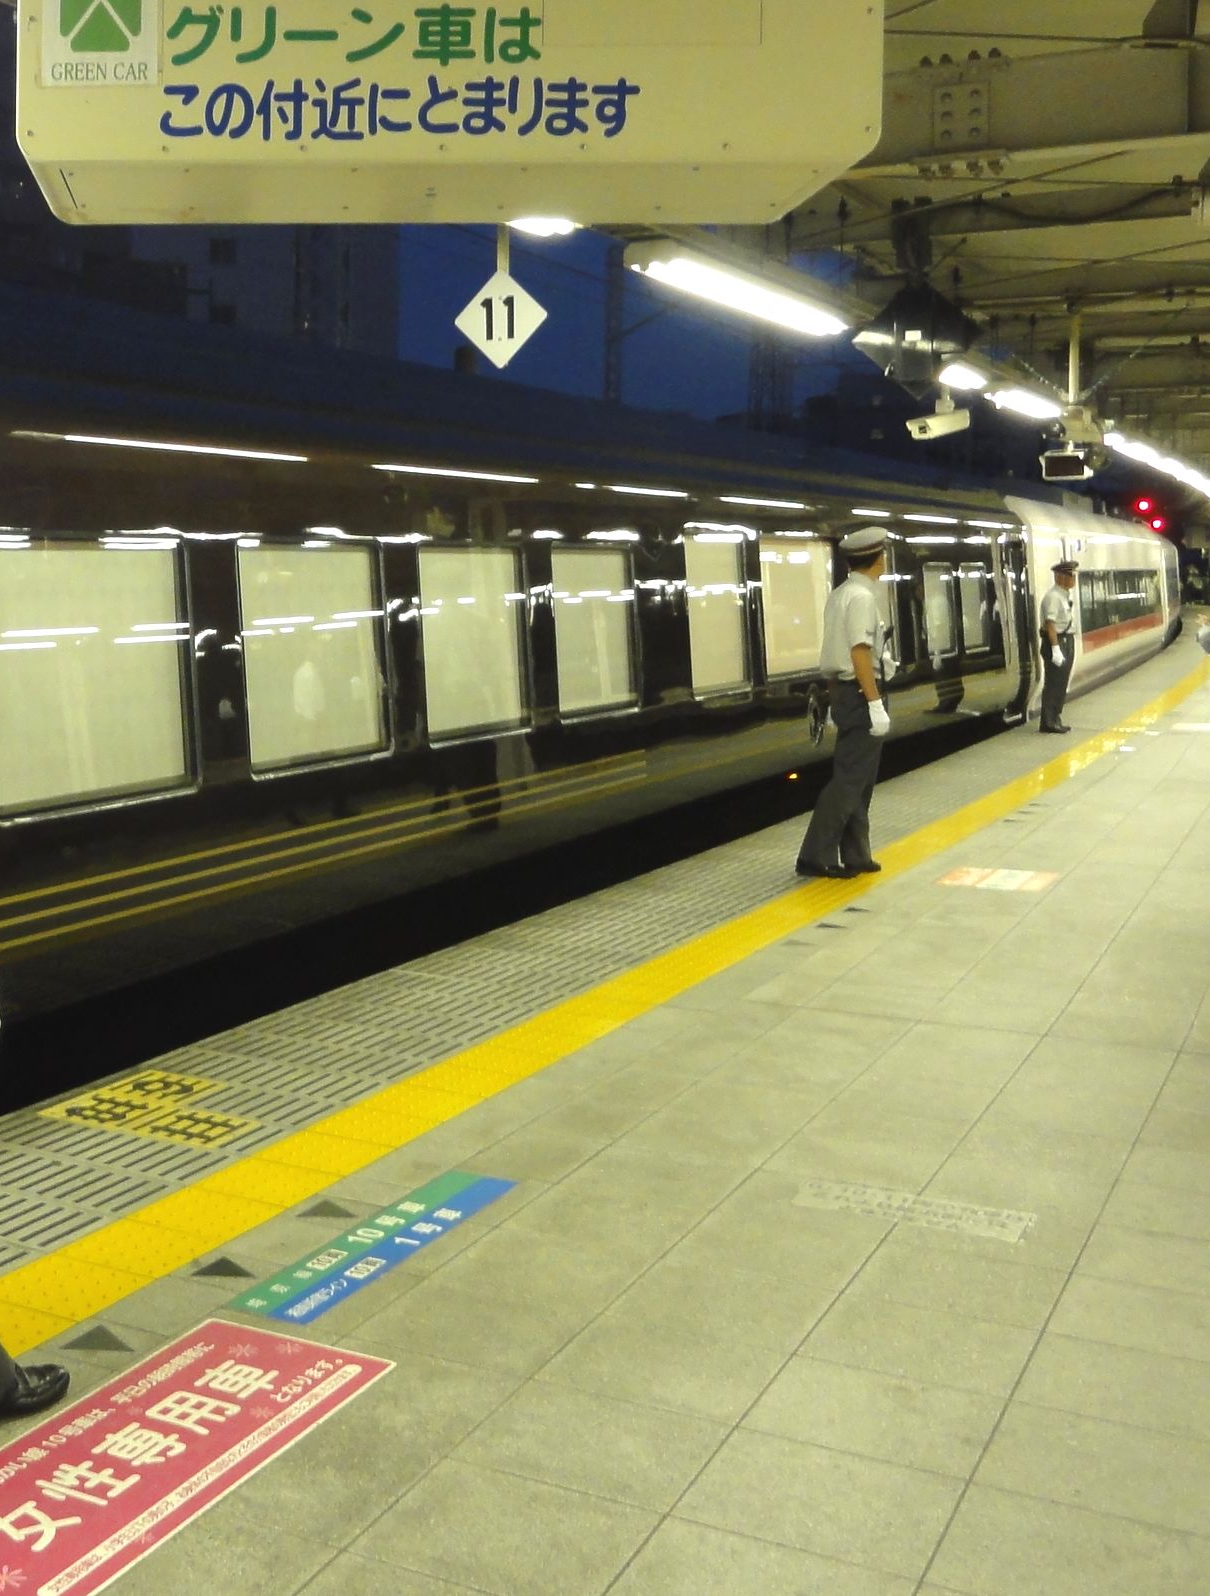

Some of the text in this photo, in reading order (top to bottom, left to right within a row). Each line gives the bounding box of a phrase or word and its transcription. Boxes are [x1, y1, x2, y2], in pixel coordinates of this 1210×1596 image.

[166, 4, 542, 66] グリーン車は
[51, 62, 148, 81] GREEN CAR
[160, 75, 641, 140] この付近にとまります
[480, 295, 515, 341] 11
